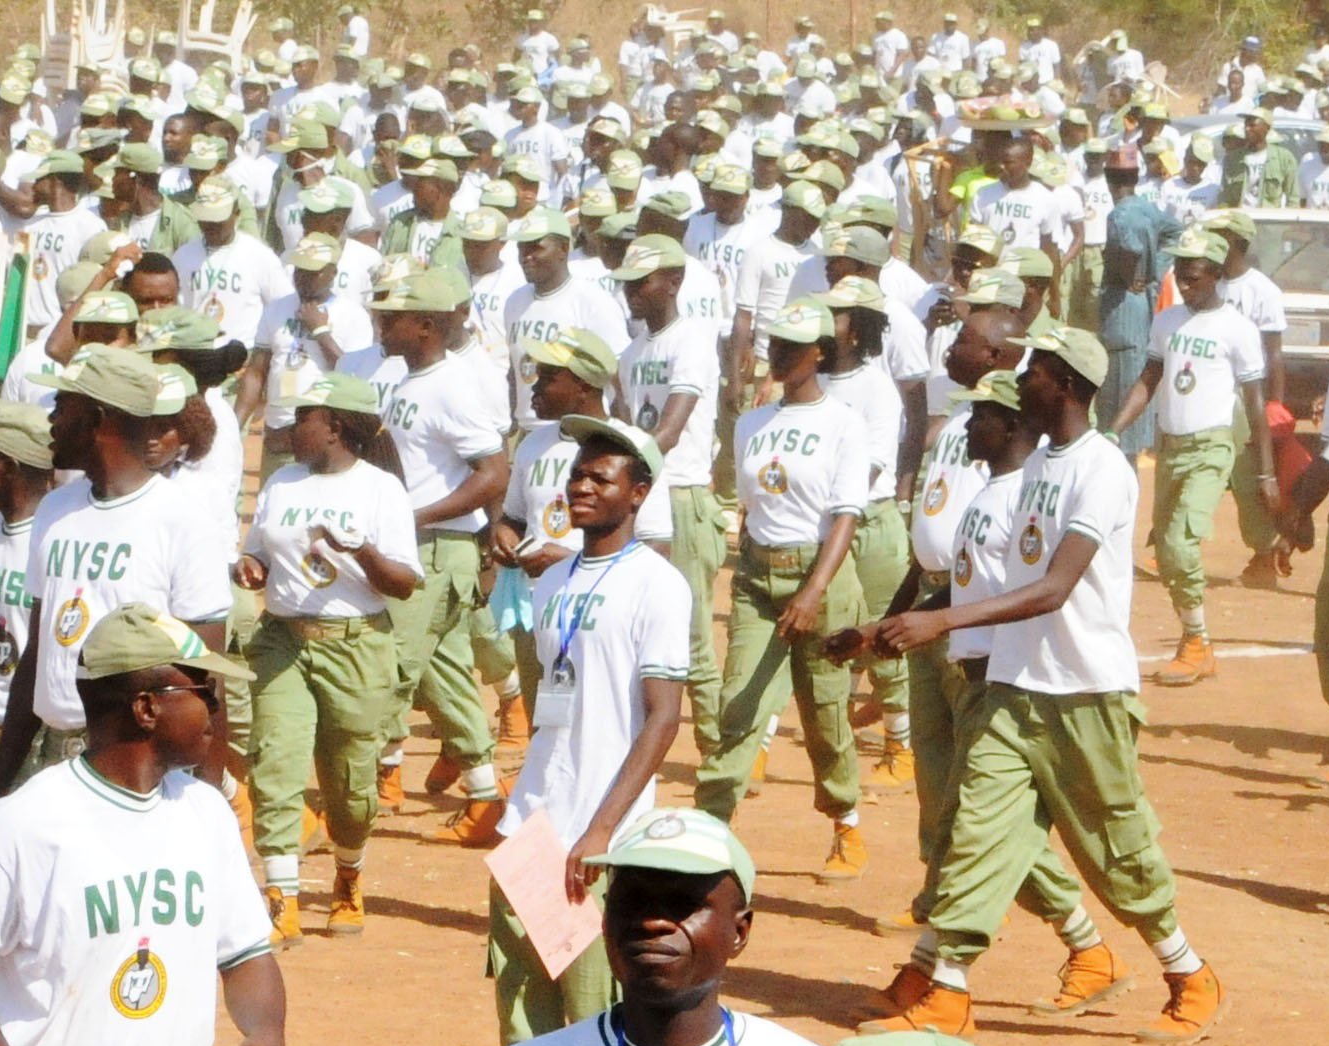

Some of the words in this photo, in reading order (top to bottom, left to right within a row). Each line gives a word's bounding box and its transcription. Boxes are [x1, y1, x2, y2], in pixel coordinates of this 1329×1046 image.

[994, 201, 1032, 219] NYSC
[36, 233, 64, 253] YSC
[417, 234, 435, 255] YS
[699, 242, 744, 265] NYSC
[191, 269, 241, 294] NYSC
[512, 321, 559, 344] NYSC
[1167, 333, 1216, 359] NYSC
[632, 361, 668, 385] NYSC
[747, 428, 821, 458] NYSC
[530, 458, 567, 488] NY
[1020, 480, 1061, 518] NYSC
[281, 507, 355, 533] NYSC
[46, 539, 132, 581] NYSC
[83, 868, 206, 939] NYSC
